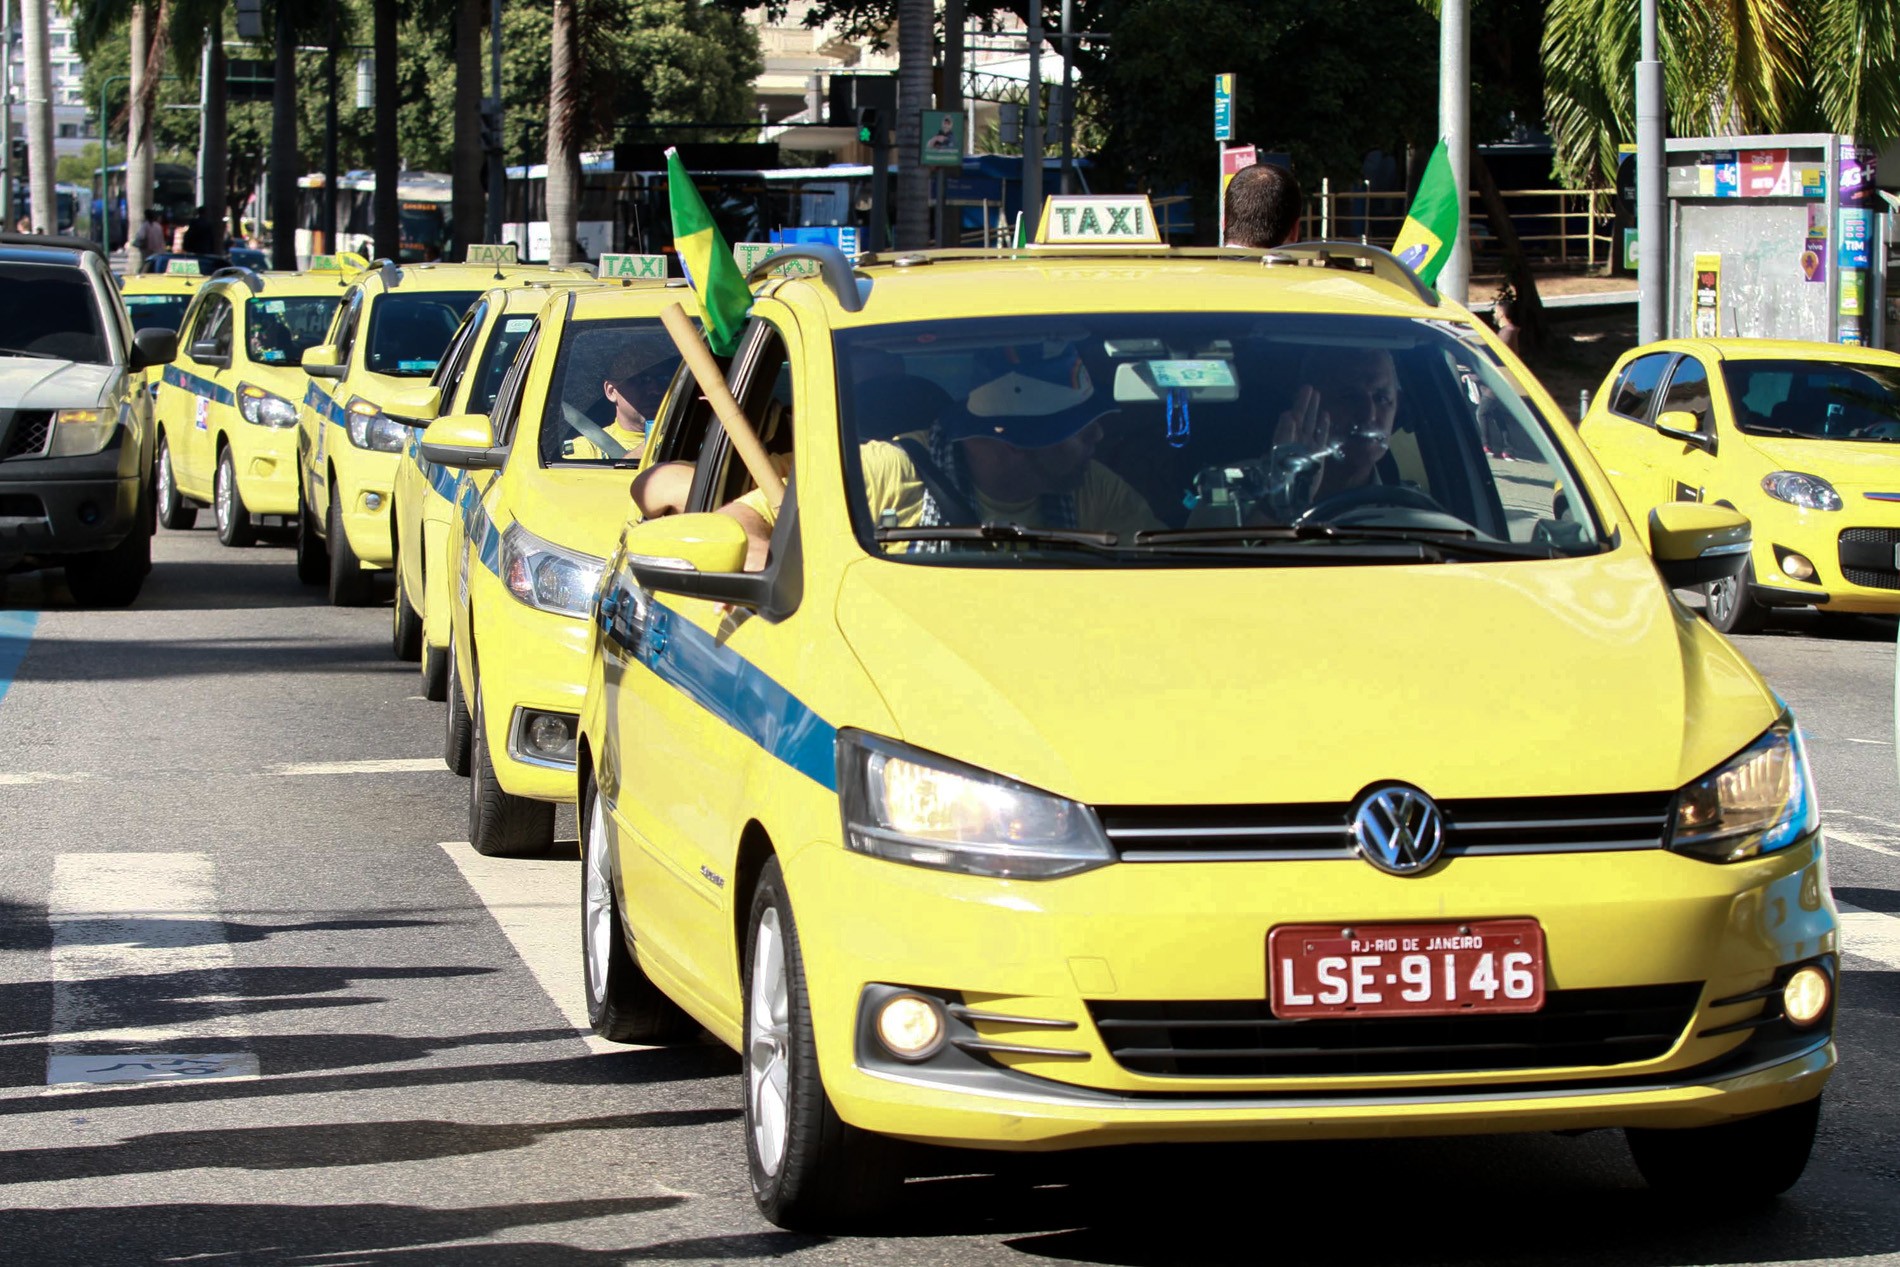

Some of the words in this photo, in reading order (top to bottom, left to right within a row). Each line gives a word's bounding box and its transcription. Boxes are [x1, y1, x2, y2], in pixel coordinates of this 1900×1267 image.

[1055, 207, 1144, 235] TAXI
[1845, 240, 1864, 250] TIM
[470, 246, 514, 261] TAXI
[603, 255, 664, 277] TAXI
[1352, 938, 1398, 952] RJ-RIO
[1402, 938, 1420, 951] DE
[1426, 936, 1483, 950] JANEIRO
